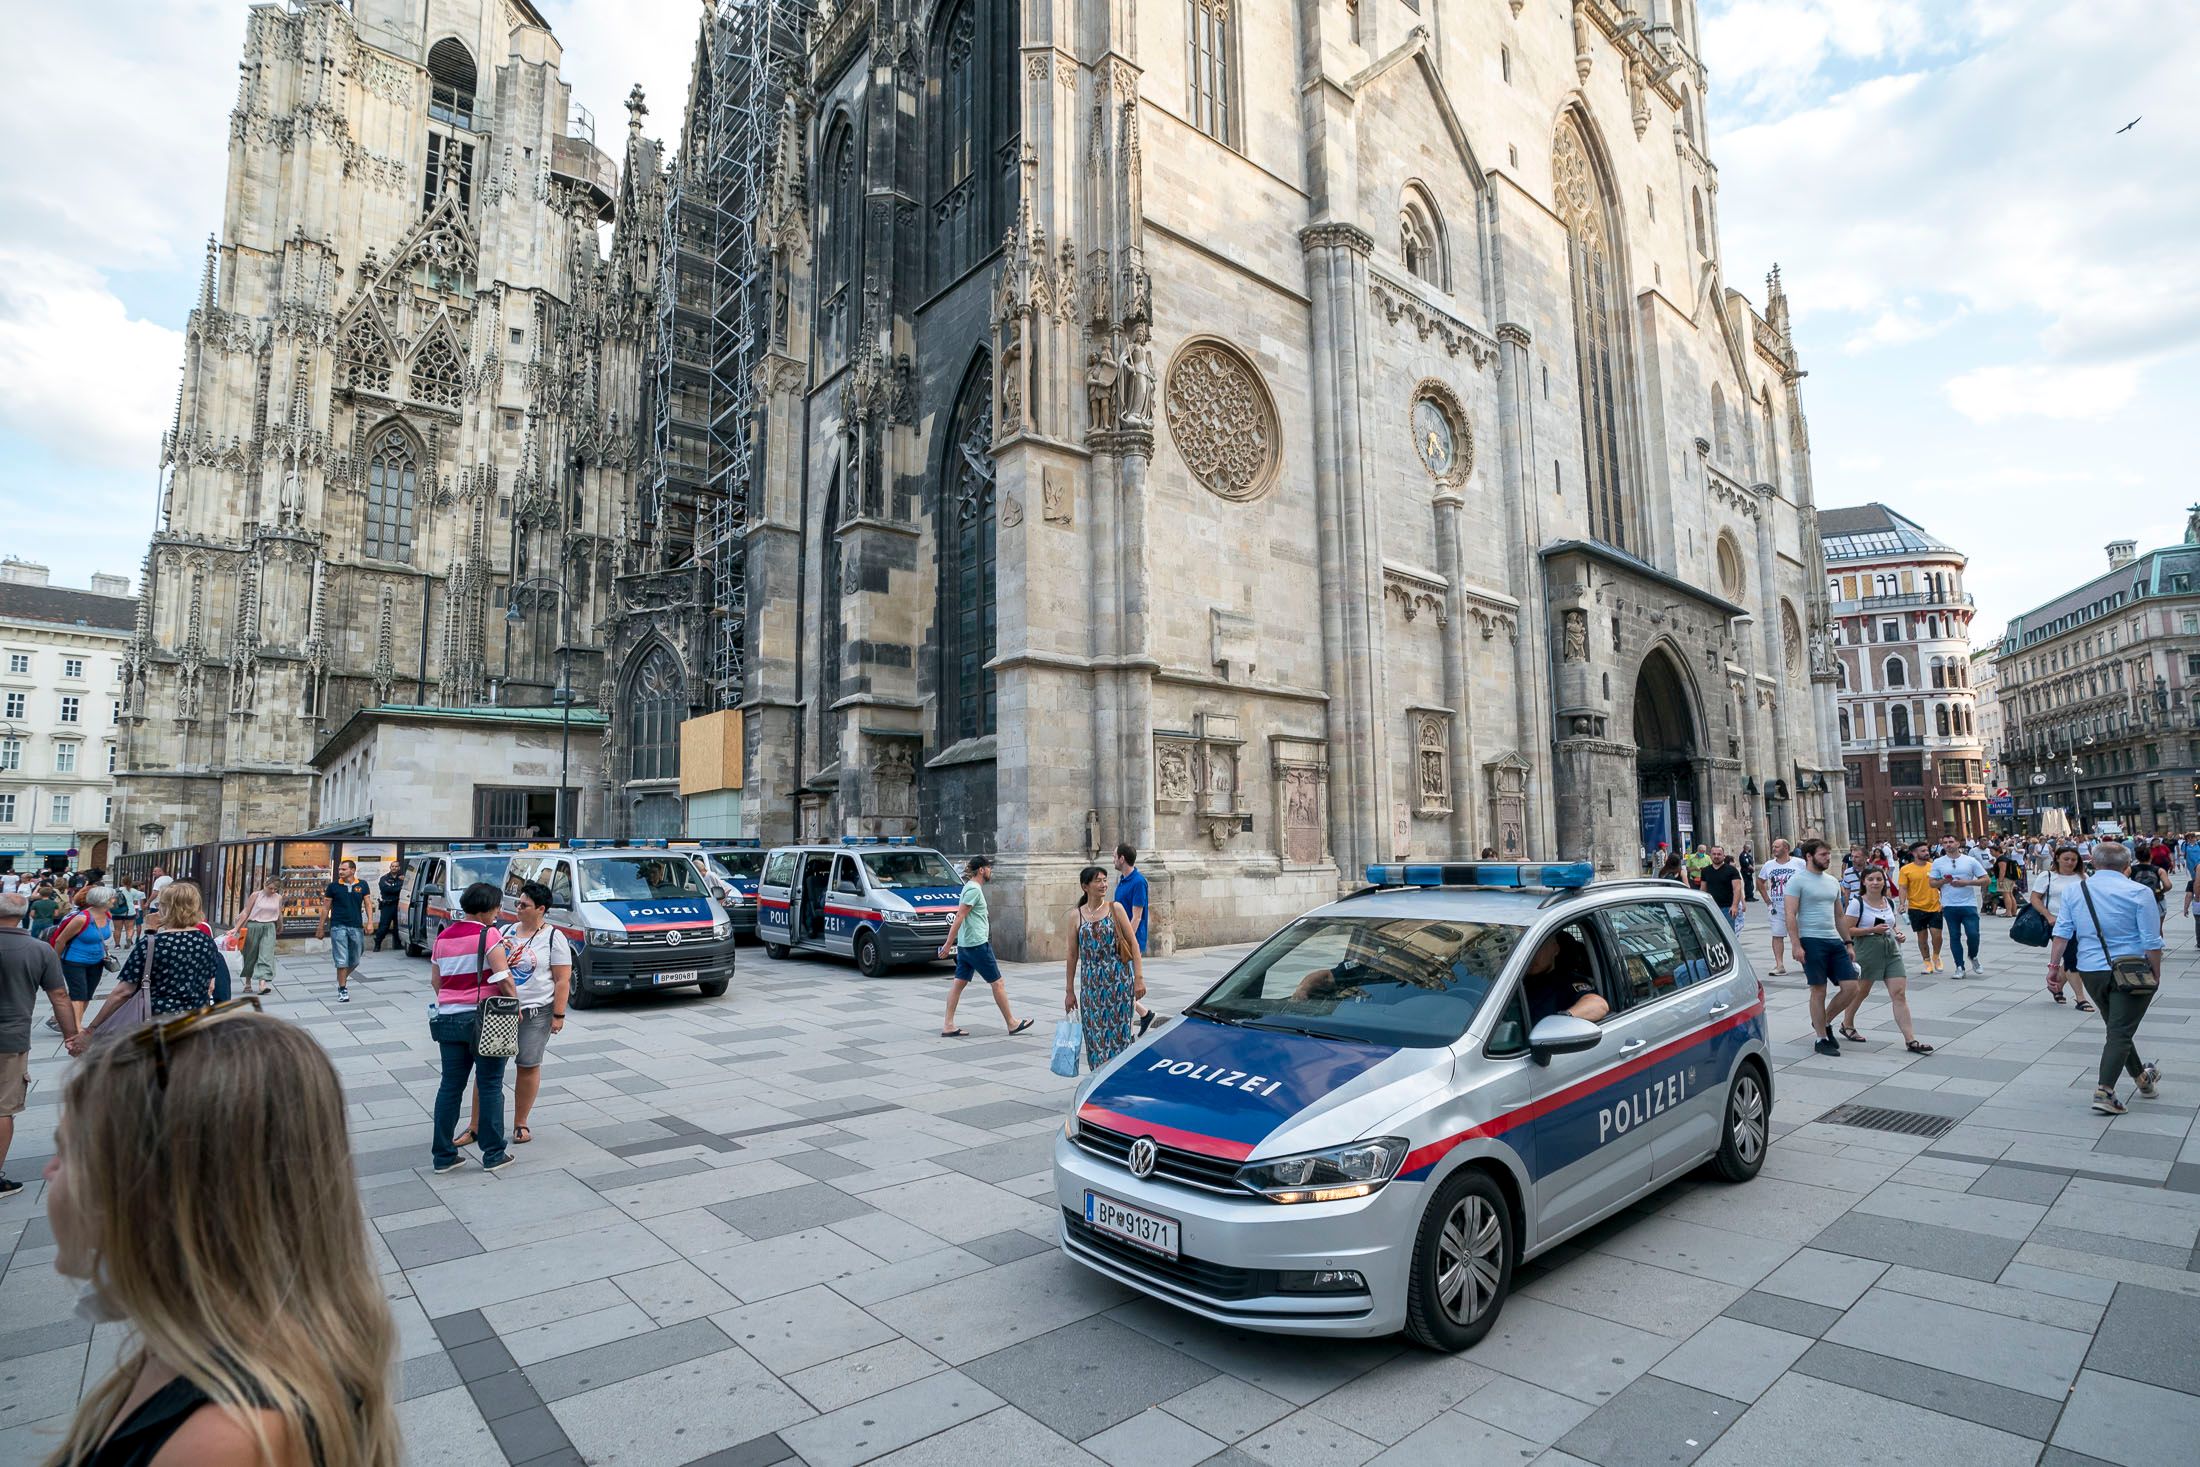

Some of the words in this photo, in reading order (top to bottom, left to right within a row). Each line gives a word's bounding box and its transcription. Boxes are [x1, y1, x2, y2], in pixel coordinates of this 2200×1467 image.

[914, 893, 961, 902] POLIZE
[629, 905, 699, 917] POLIZEI
[770, 910, 789, 925] POLI
[824, 916, 840, 932] ZEI
[666, 930, 682, 946] VW
[674, 972, 695, 981] 90481
[1147, 1058, 1283, 1097] POLIZEI
[1599, 1070, 1685, 1144] POLIZEI
[1129, 1139, 1156, 1178] VW
[1126, 1211, 1168, 1247] 91371
